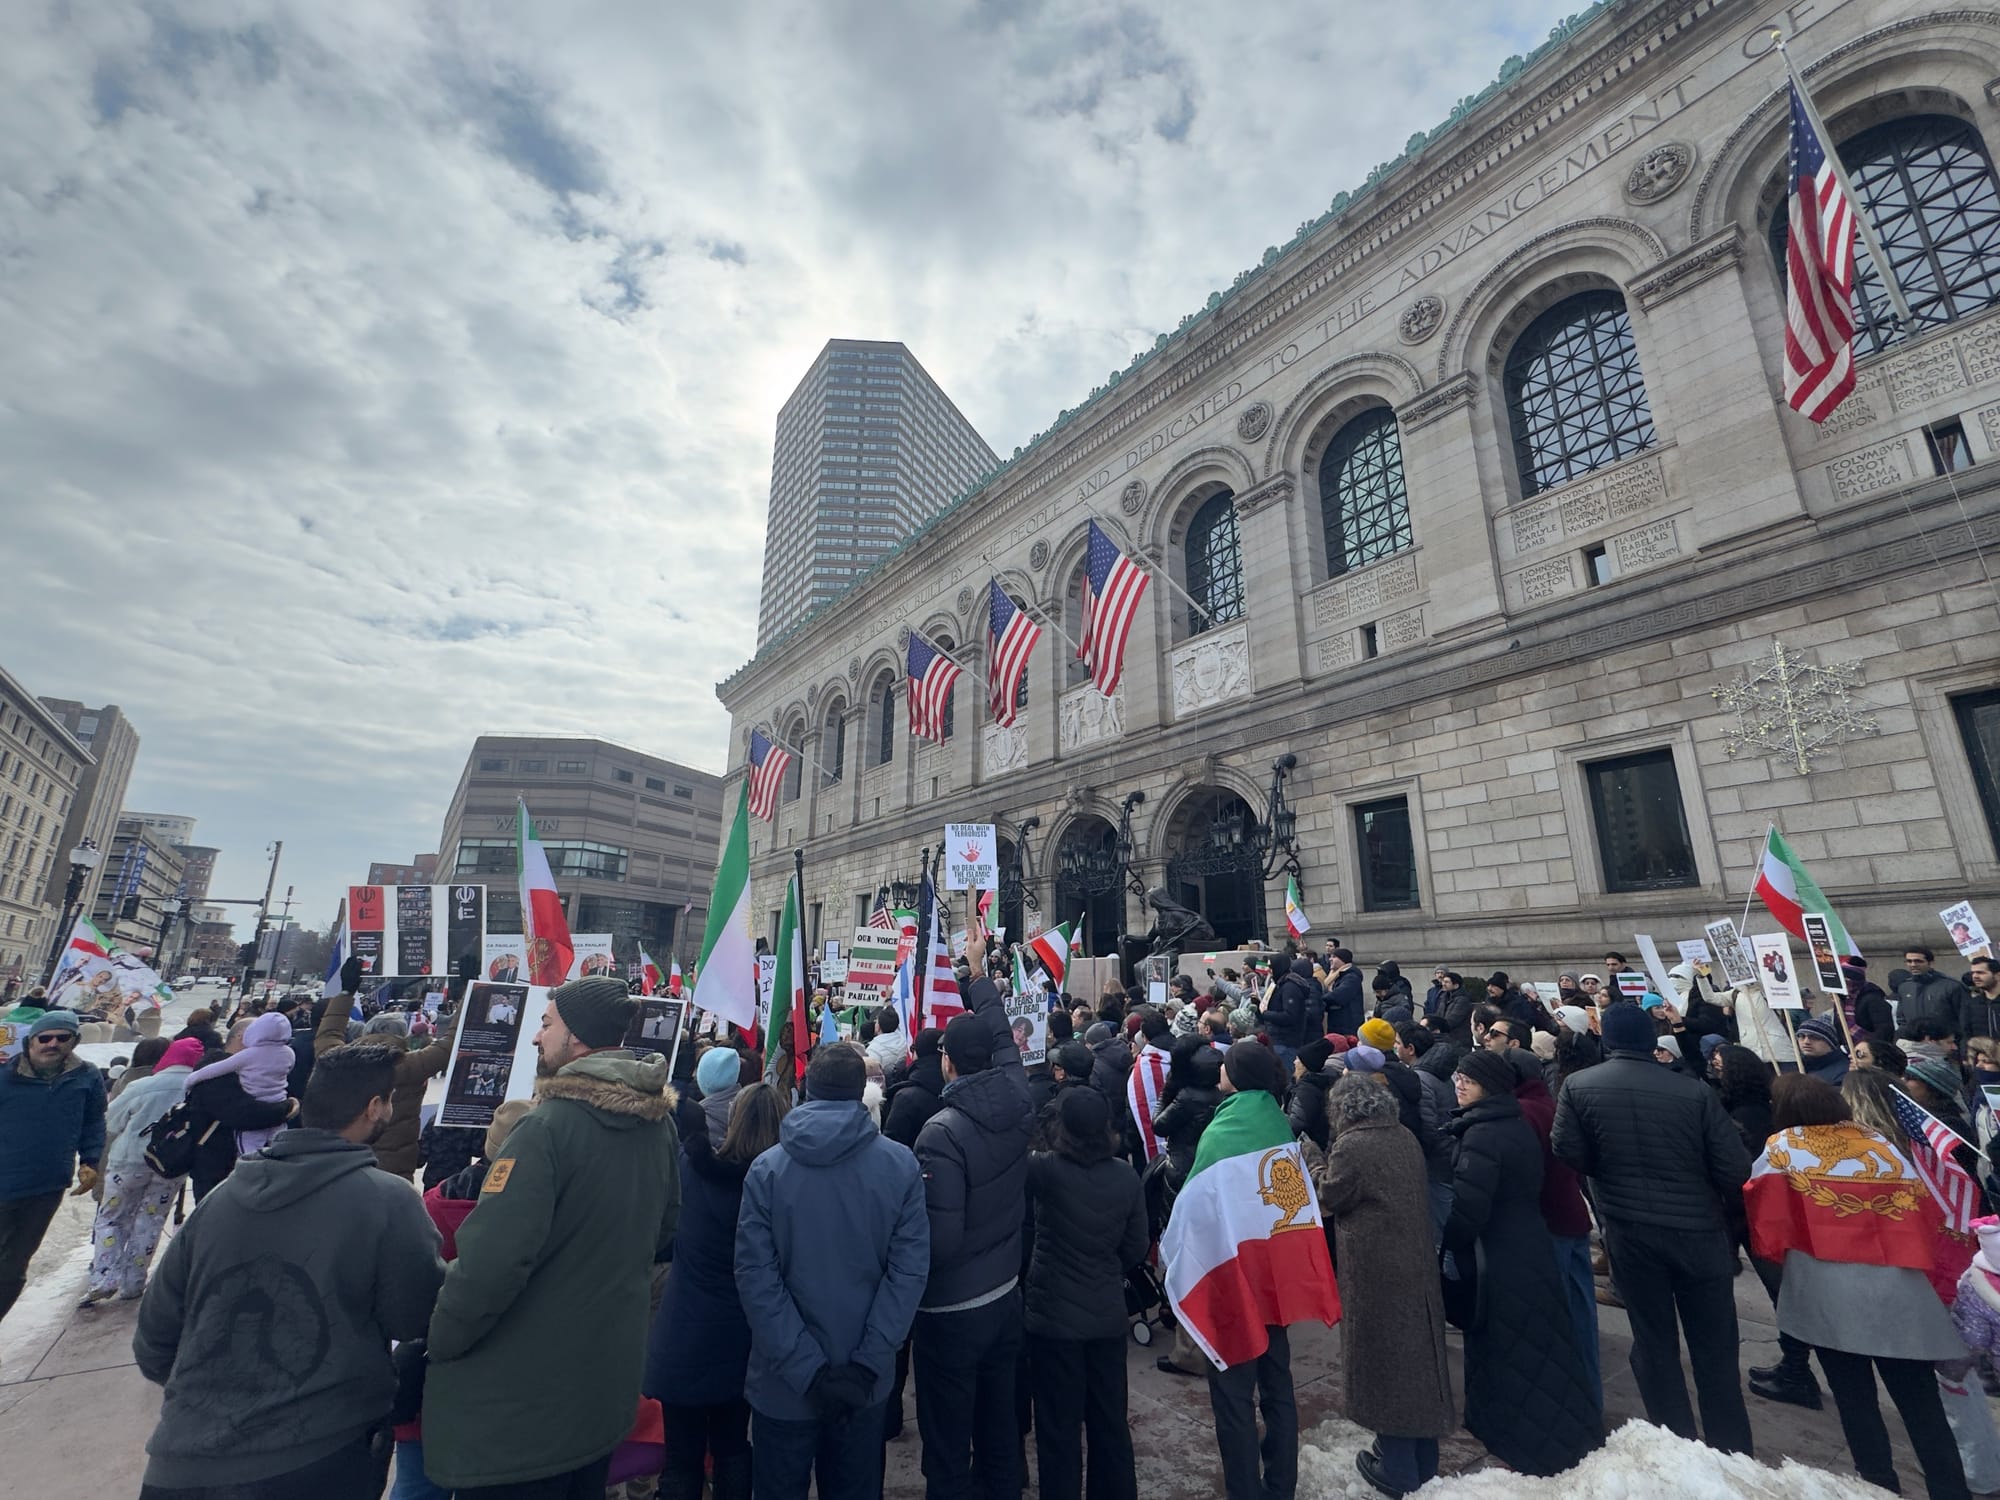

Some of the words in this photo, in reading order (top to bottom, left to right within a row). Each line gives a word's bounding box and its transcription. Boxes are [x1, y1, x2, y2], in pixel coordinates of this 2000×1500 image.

[914, 578, 944, 607] BUILT
[950, 565, 966, 584] BY
[1010, 501, 1064, 546] PEOPLE
[1074, 469, 1110, 503] AND
[1125, 381, 1243, 471] DEDICATED
[1264, 342, 1299, 375] TO
[1316, 290, 1377, 339] THE
[1396, 74, 1697, 292] ADVANCEMENT
[1741, 0, 1815, 59] OF
[1886, 340, 1951, 372] HOOKER
[1895, 372, 1959, 401] BROWNE
[1820, 404, 1871, 430] DARWIN
[1831, 440, 1904, 472] COLVMBVS
[1608, 461, 1649, 483] ARNOLD
[1835, 457, 1886, 481] CABOT
[1609, 469, 1654, 490] ASCHAM
[1610, 476, 1660, 500] CHAPMAN
[1840, 473, 1902, 499] RALEIGH
[1562, 483, 1595, 501] SYDNEY
[1513, 501, 1552, 520] ADDISON
[1562, 493, 1592, 510] DEFOE
[1564, 499, 1601, 517] BUNYAN
[1515, 511, 1546, 528] STEELE
[1567, 514, 1604, 533] WALTON
[1516, 522, 1541, 537] SWIFT
[1517, 524, 1558, 544] CARLYLE
[1519, 537, 1546, 552] LAMB
[1621, 532, 1669, 554] RABELAIS
[1622, 544, 1657, 562] RACINE
[1524, 558, 1567, 579] JOHNSON
[1526, 575, 1567, 594] CAXTON
[1528, 588, 1554, 602] AMES
[494, 815, 560, 833] WETIN
[857, 934, 872, 943] OUR
[876, 936, 898, 945] VOICE
[856, 961, 872, 969] FREE
[876, 962, 892, 970] IRAN
[860, 983, 878, 991] REZA
[847, 992, 880, 1002] PAHLAVI
[1014, 994, 1034, 1008] YEARS
[1035, 992, 1048, 1003] OLD
[1006, 1006, 1022, 1017] SHOT
[1023, 1003, 1040, 1015] DEAD
[1037, 1012, 1046, 1022] BY
[1021, 1049, 1045, 1062] FORCES
